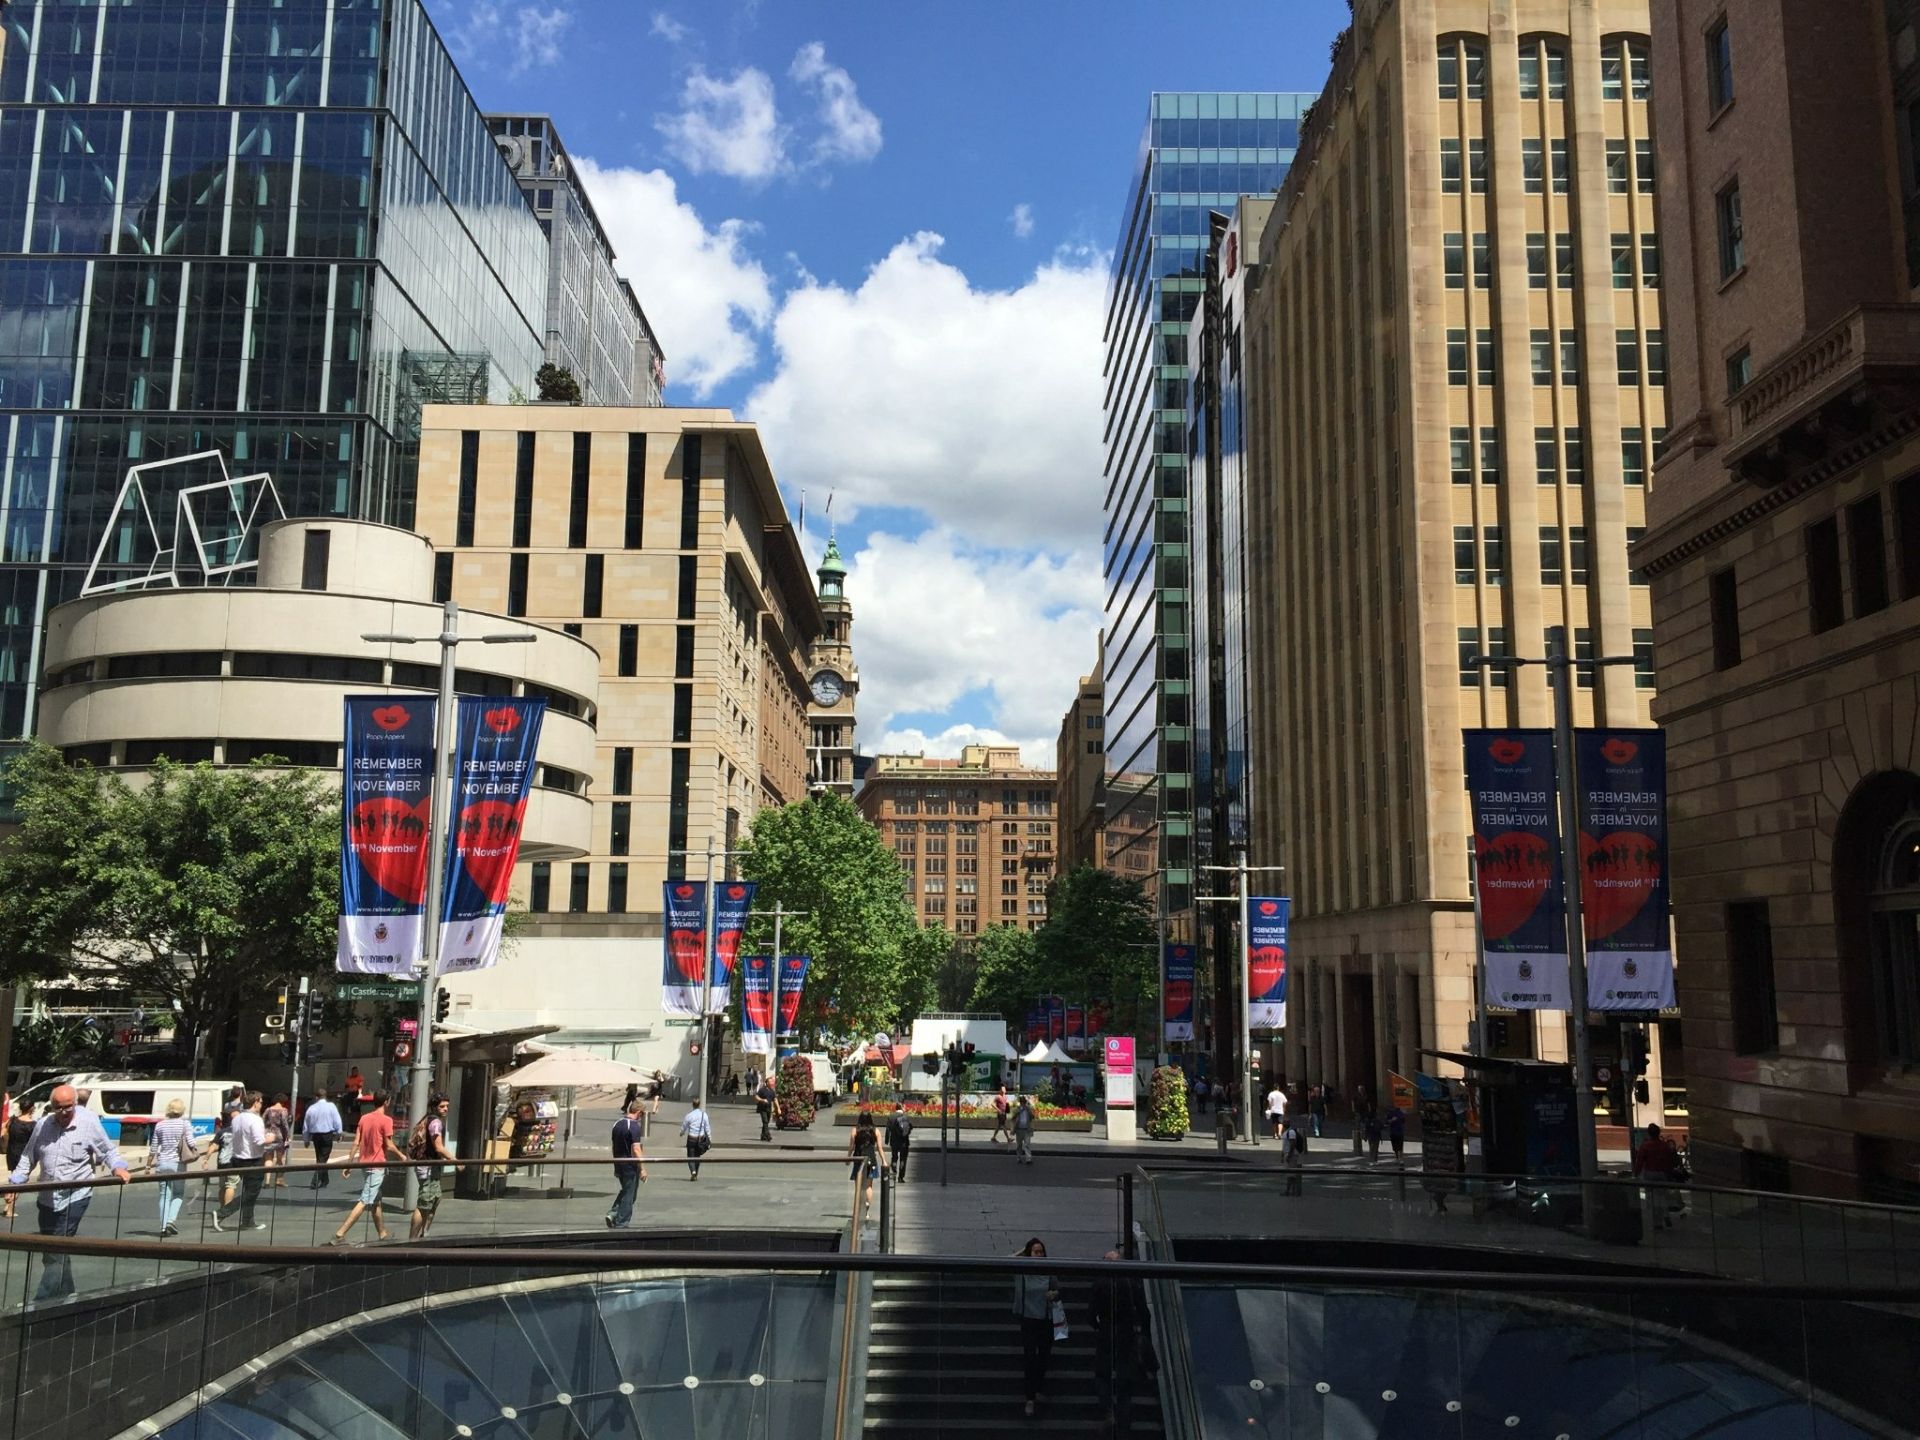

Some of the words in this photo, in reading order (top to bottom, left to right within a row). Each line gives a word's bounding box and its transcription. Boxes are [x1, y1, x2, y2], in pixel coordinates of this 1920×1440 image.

[353, 758, 422, 769] REMEMBER
[353, 780, 421, 792] NOVEMBER
[369, 843, 418, 853] November
